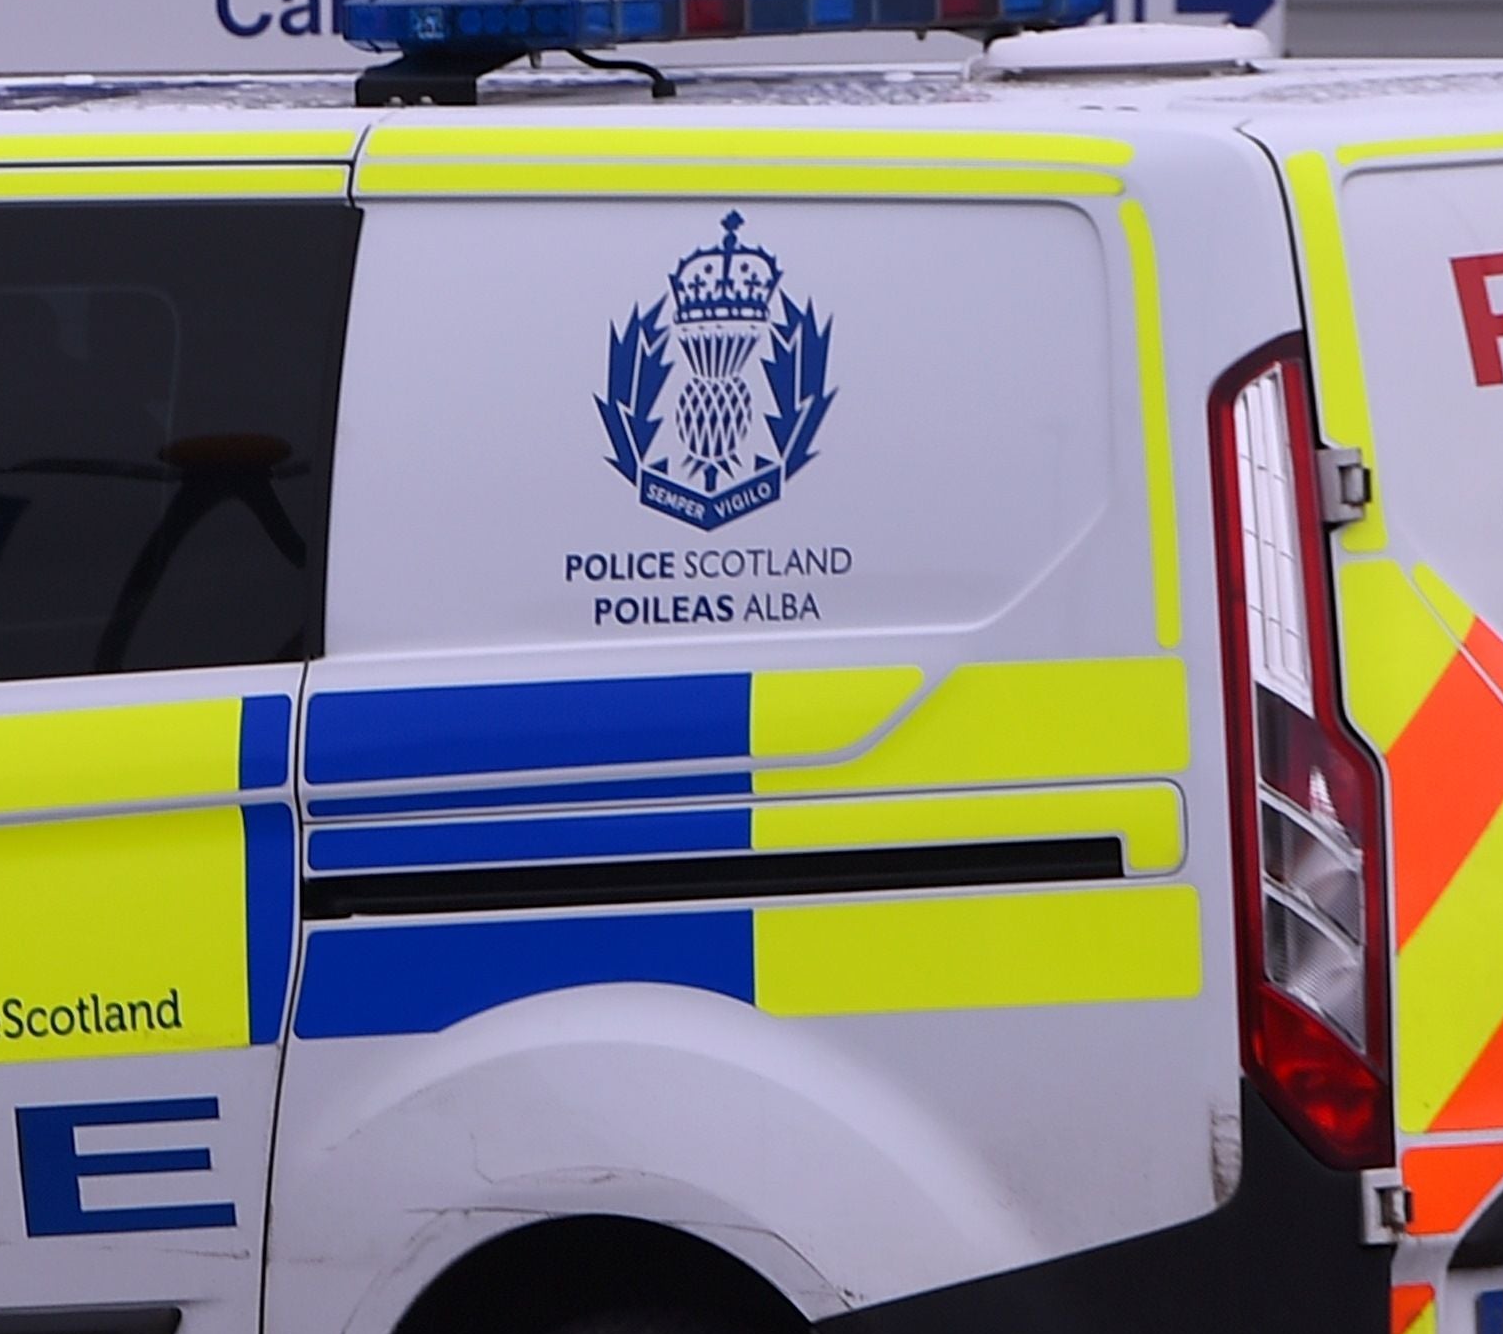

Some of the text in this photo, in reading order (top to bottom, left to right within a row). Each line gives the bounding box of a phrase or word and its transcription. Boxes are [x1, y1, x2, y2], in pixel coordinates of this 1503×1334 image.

[646, 481, 773, 522] SEMPER VIGILO
[564, 546, 853, 582] POLICE SCOTLAND
[594, 591, 822, 626] POILEAS ALBA
